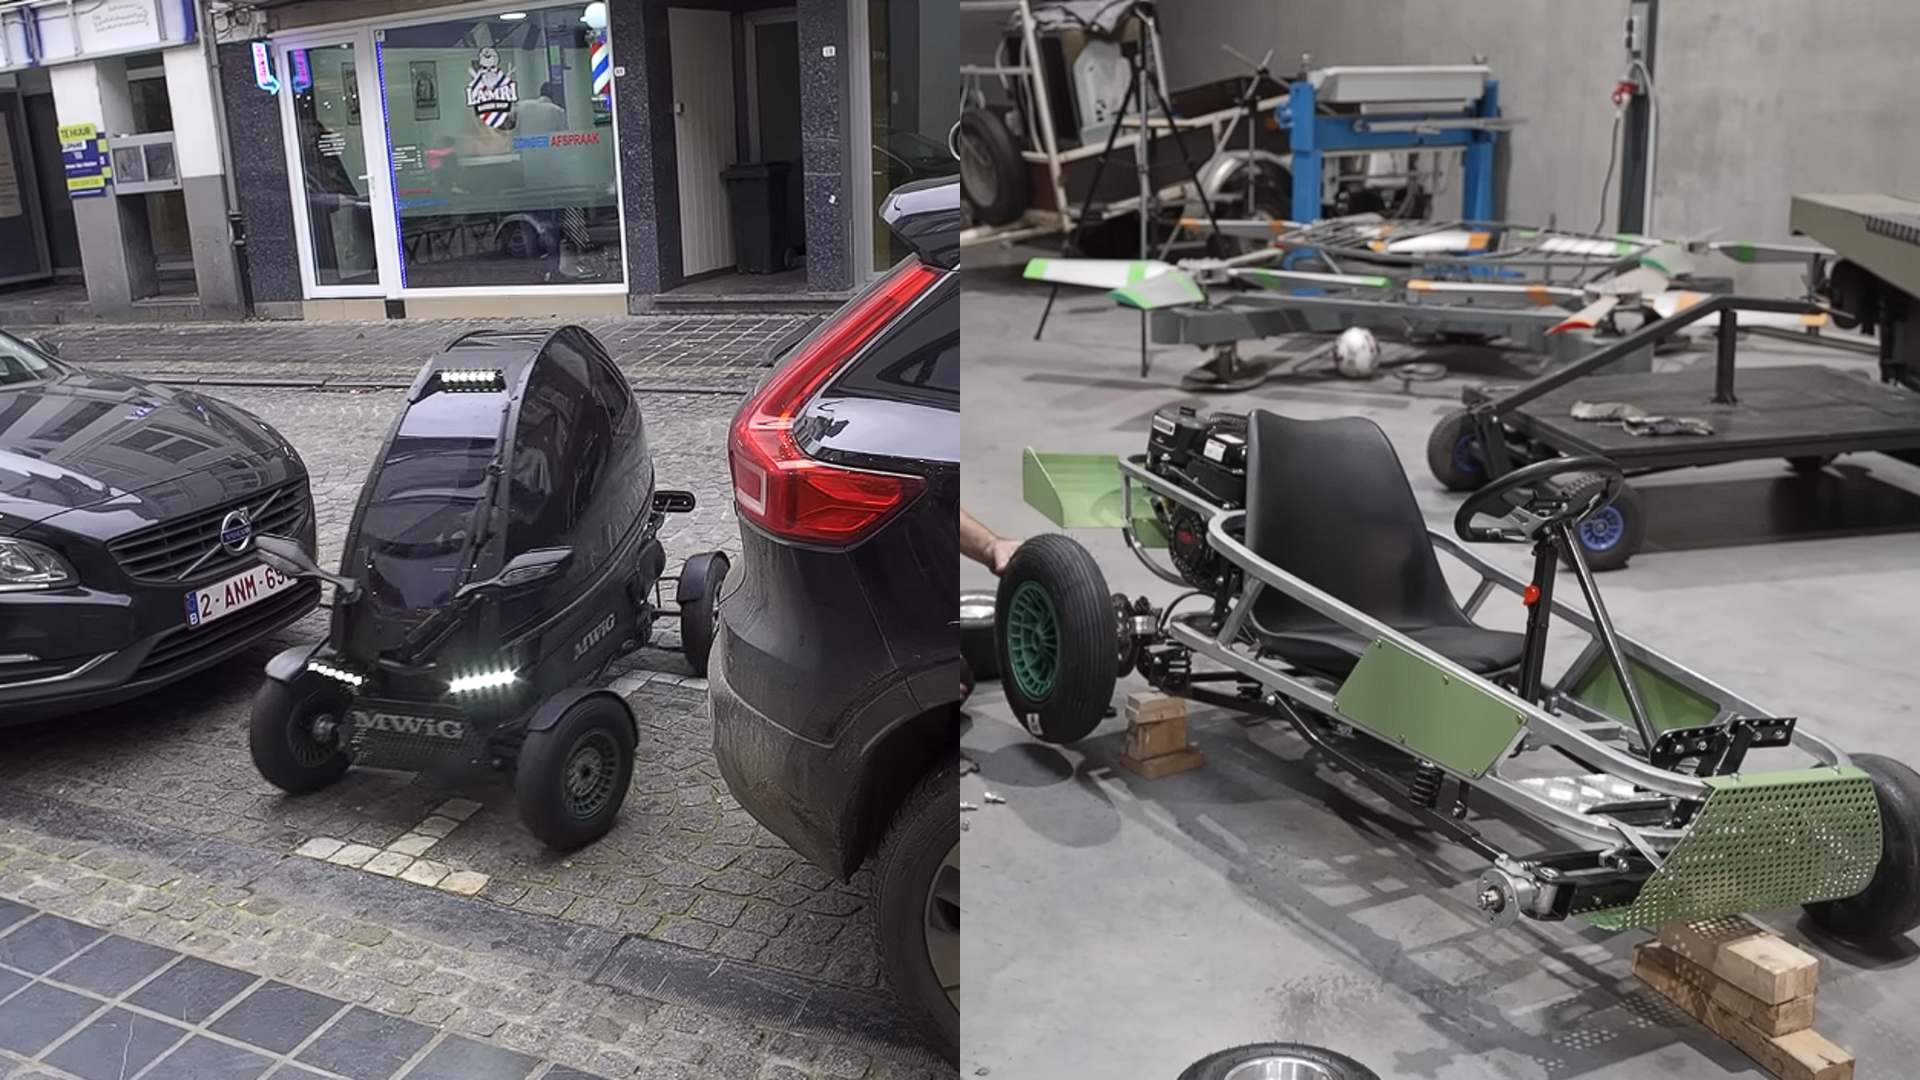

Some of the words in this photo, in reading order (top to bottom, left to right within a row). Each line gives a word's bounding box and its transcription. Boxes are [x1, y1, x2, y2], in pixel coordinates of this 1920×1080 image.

[466, 82, 517, 105] LAMRI
[551, 132, 599, 147] AFSPRAAK
[200, 567, 285, 619] 2-ANM-69
